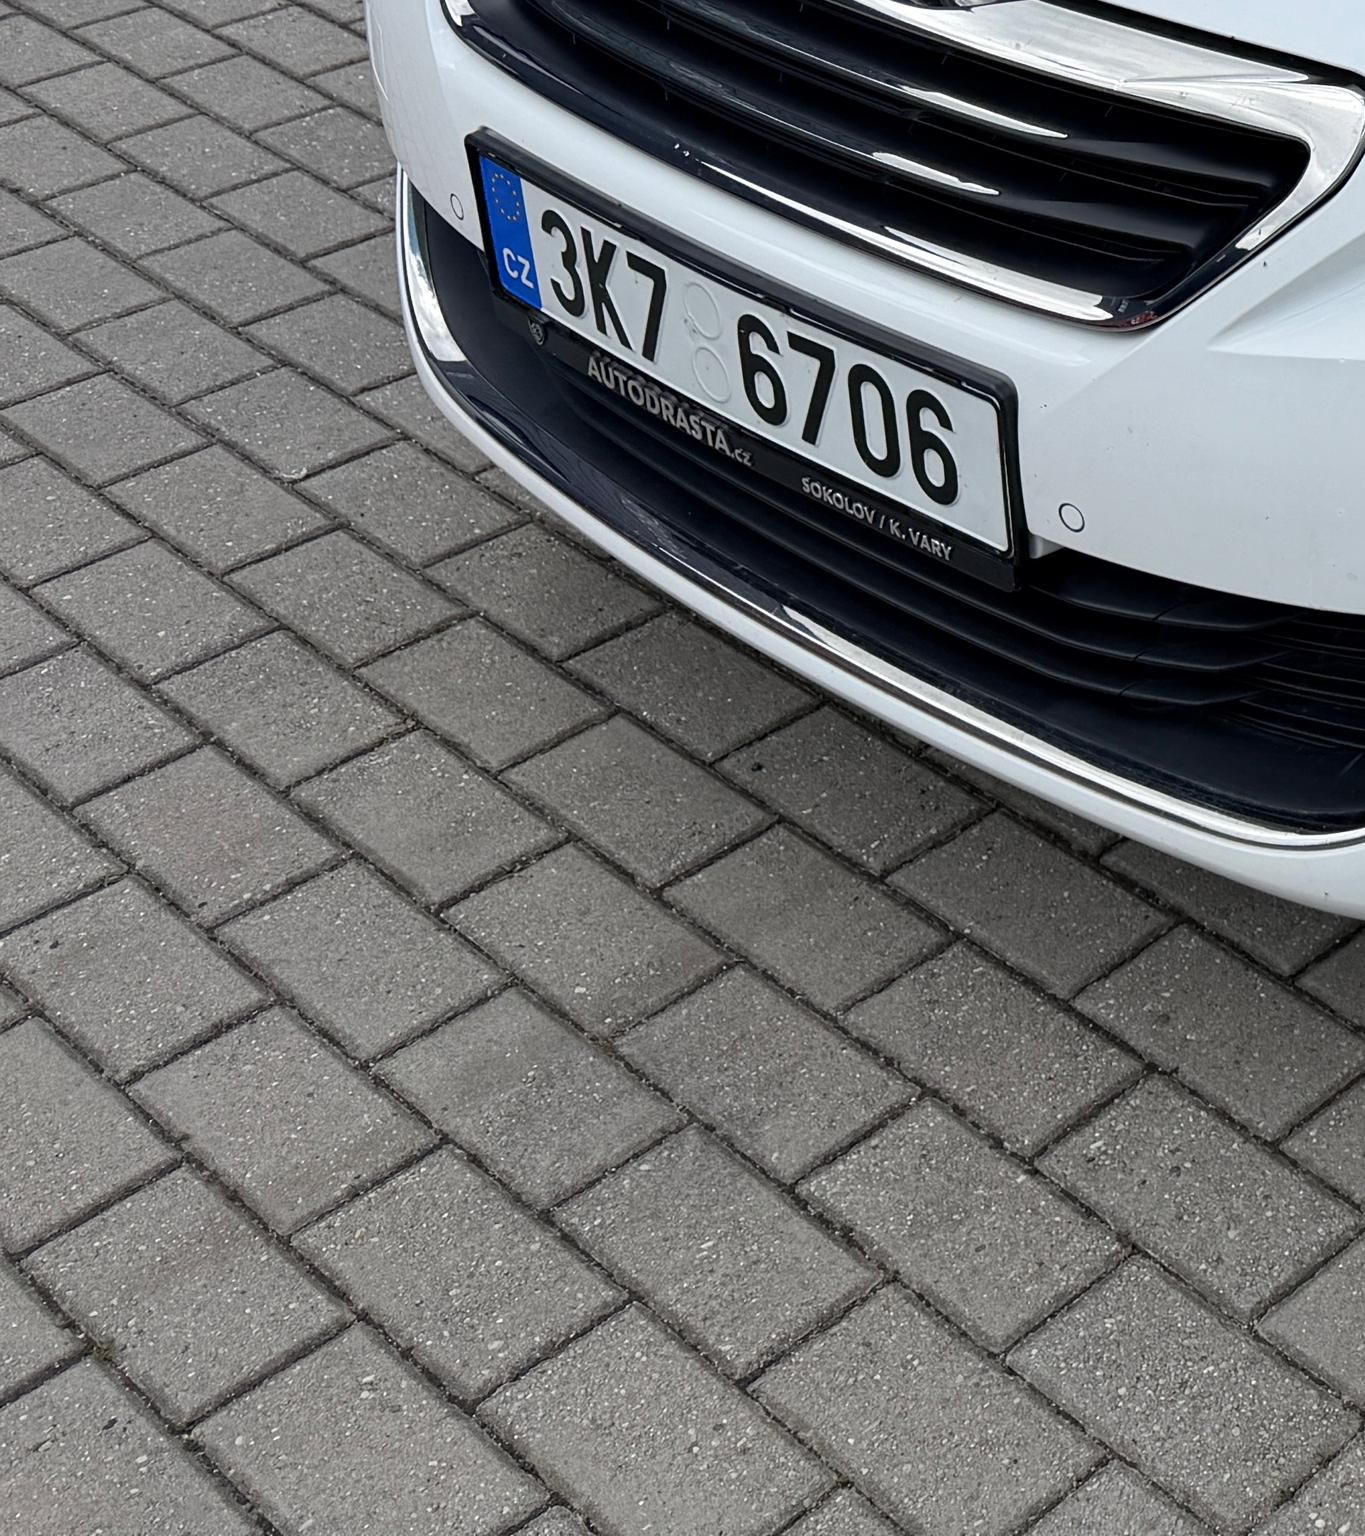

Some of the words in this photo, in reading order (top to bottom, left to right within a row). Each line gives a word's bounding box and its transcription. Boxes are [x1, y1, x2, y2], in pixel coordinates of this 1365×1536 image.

[502, 247, 534, 289] CZ
[541, 209, 667, 362] 3K7
[737, 314, 959, 506] 6706
[587, 356, 752, 467] AUTODRASTA.cz
[801, 476, 876, 525] SOKOLOV
[889, 518, 906, 540] K.
[908, 527, 953, 561] VARY
